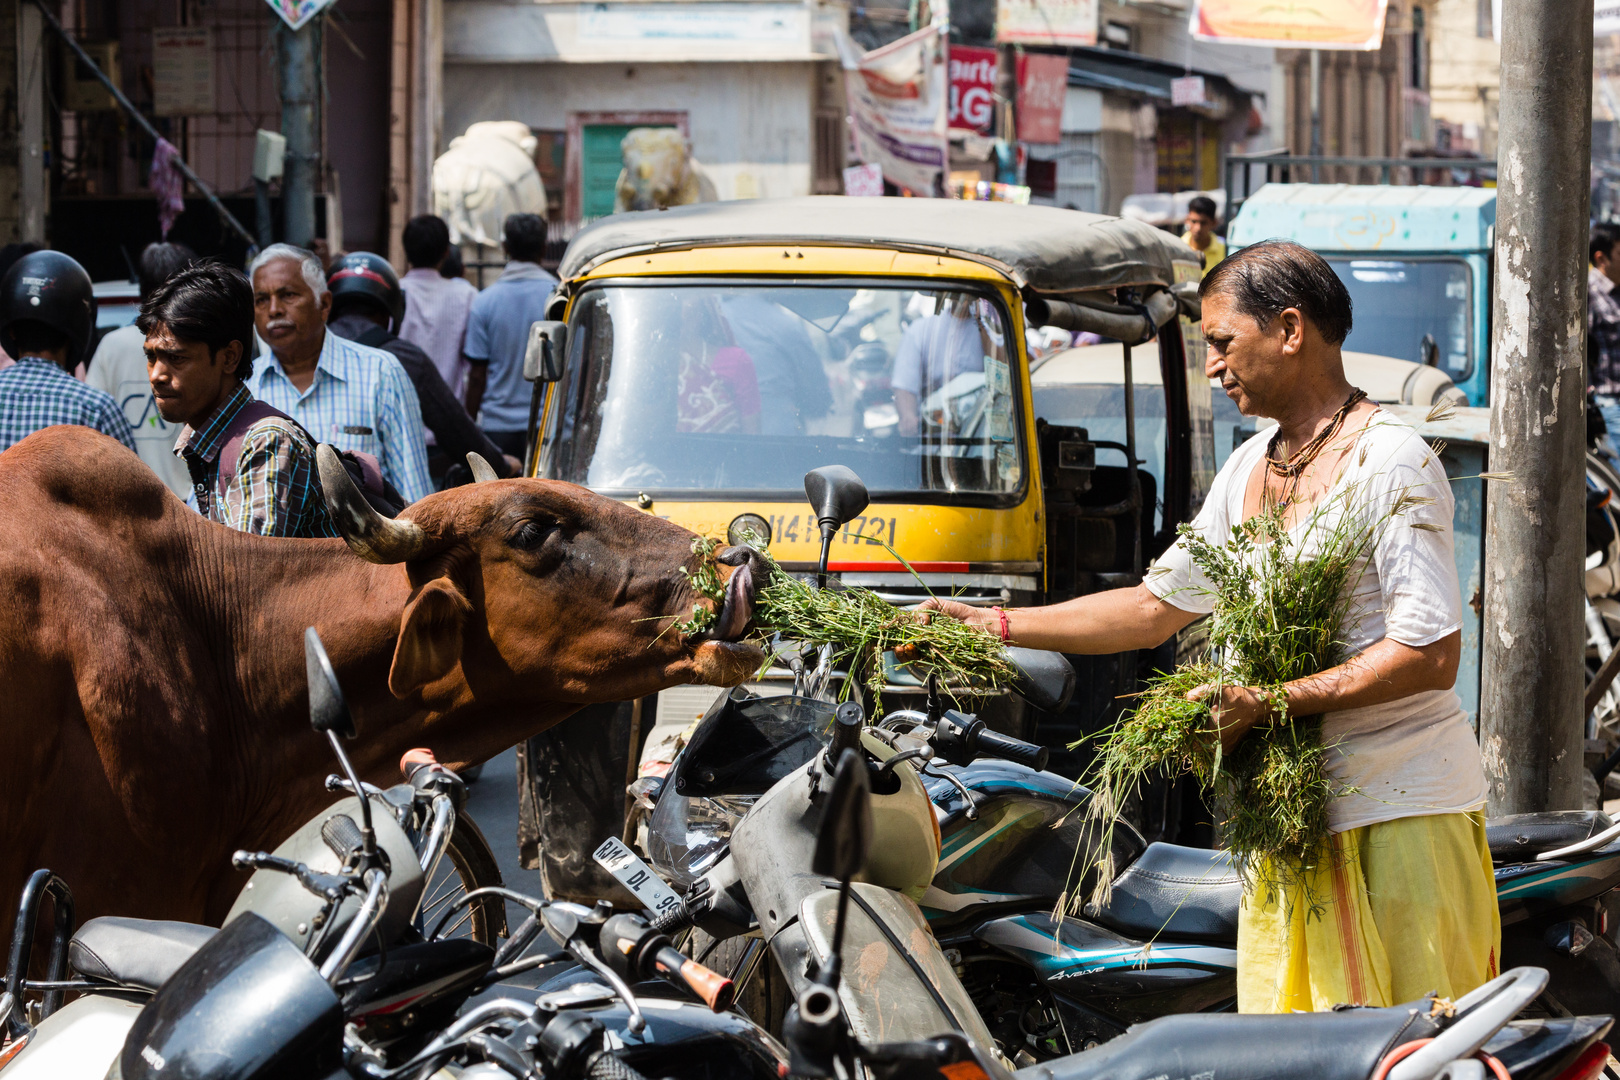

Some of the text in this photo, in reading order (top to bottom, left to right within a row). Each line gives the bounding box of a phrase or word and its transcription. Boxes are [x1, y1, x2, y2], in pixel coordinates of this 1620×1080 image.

[840, 515, 897, 548] 1721
[595, 840, 628, 868] RJ14
[626, 869, 650, 892] DL
